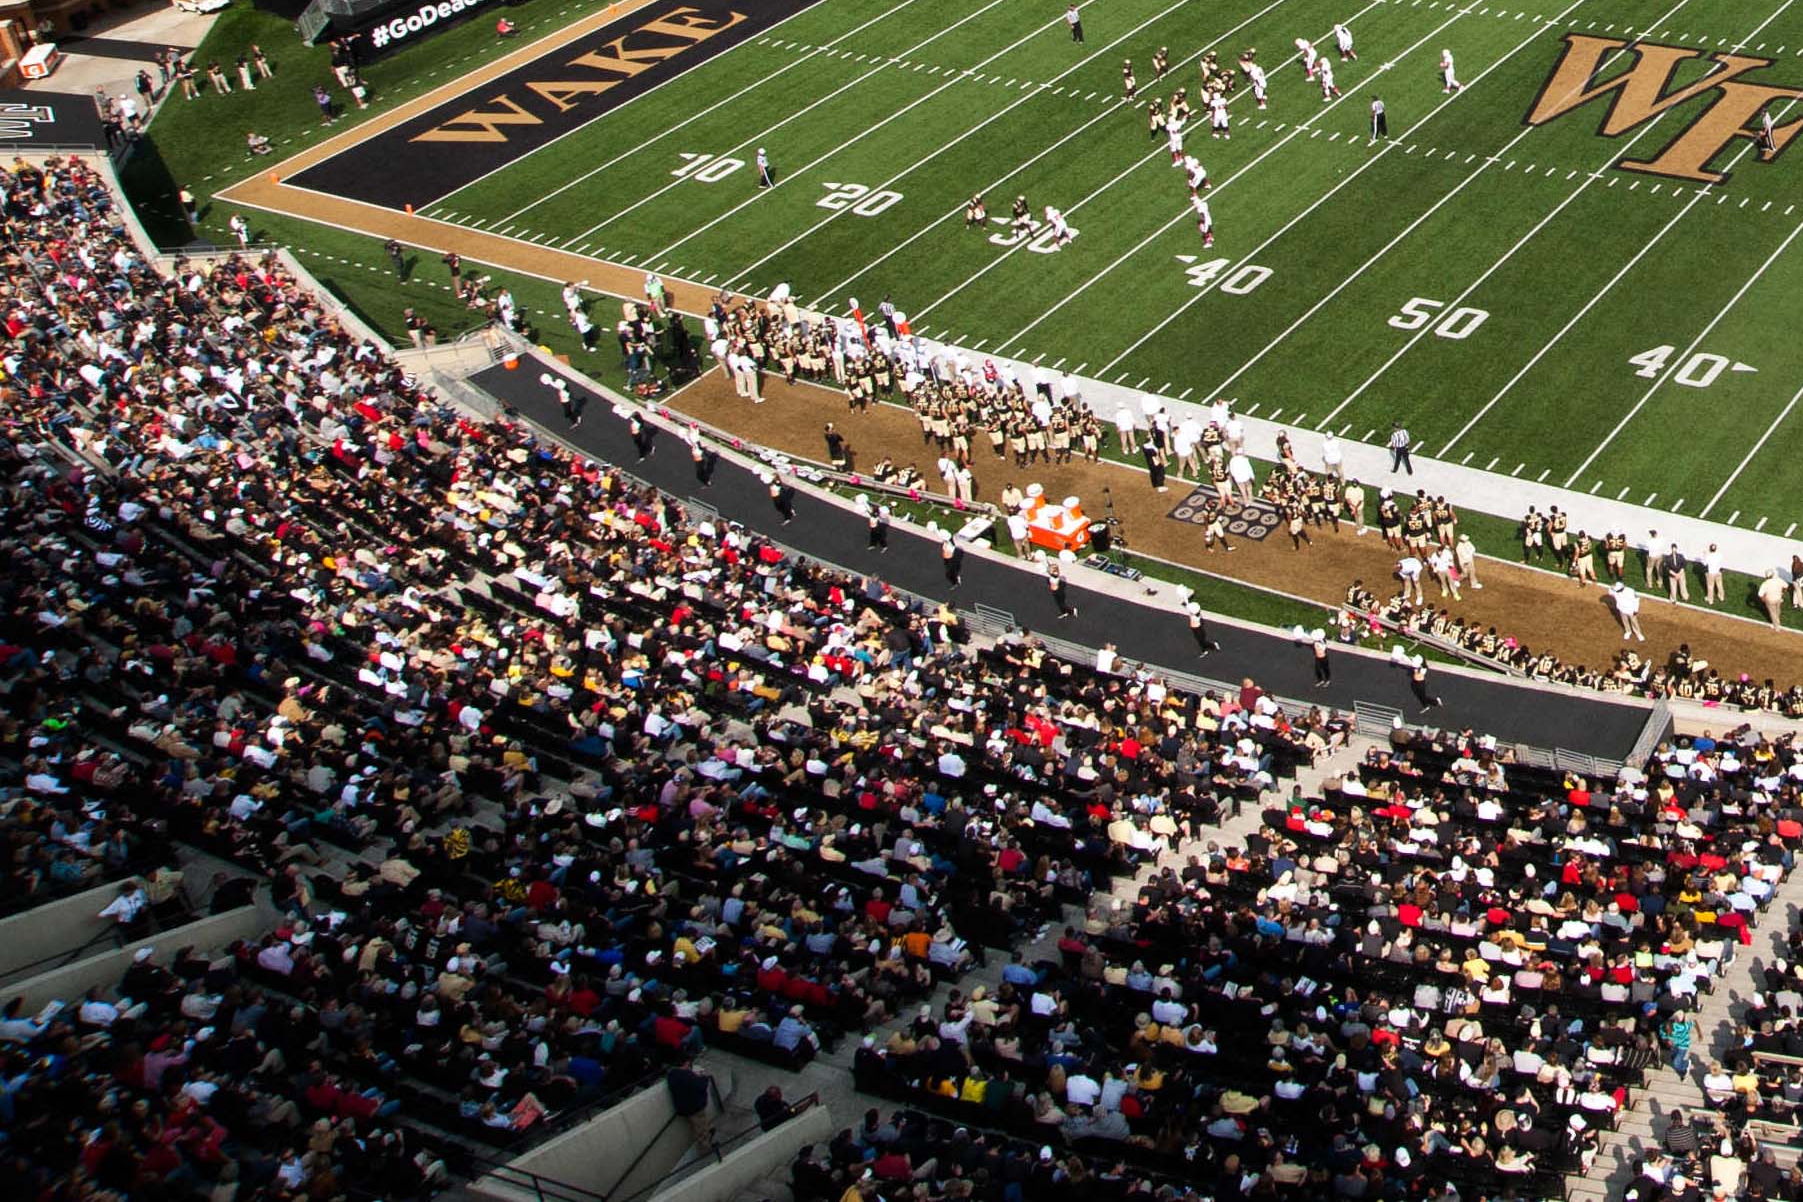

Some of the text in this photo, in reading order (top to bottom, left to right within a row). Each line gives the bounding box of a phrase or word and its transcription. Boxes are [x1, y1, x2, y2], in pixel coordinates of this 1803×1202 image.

[409, 6, 747, 143] WAKE
[670, 155, 746, 184] 10
[817, 184, 904, 217] 20
[1184, 256, 1274, 296] 40
[1388, 296, 1490, 340] 50
[1628, 345, 1730, 388] 40
